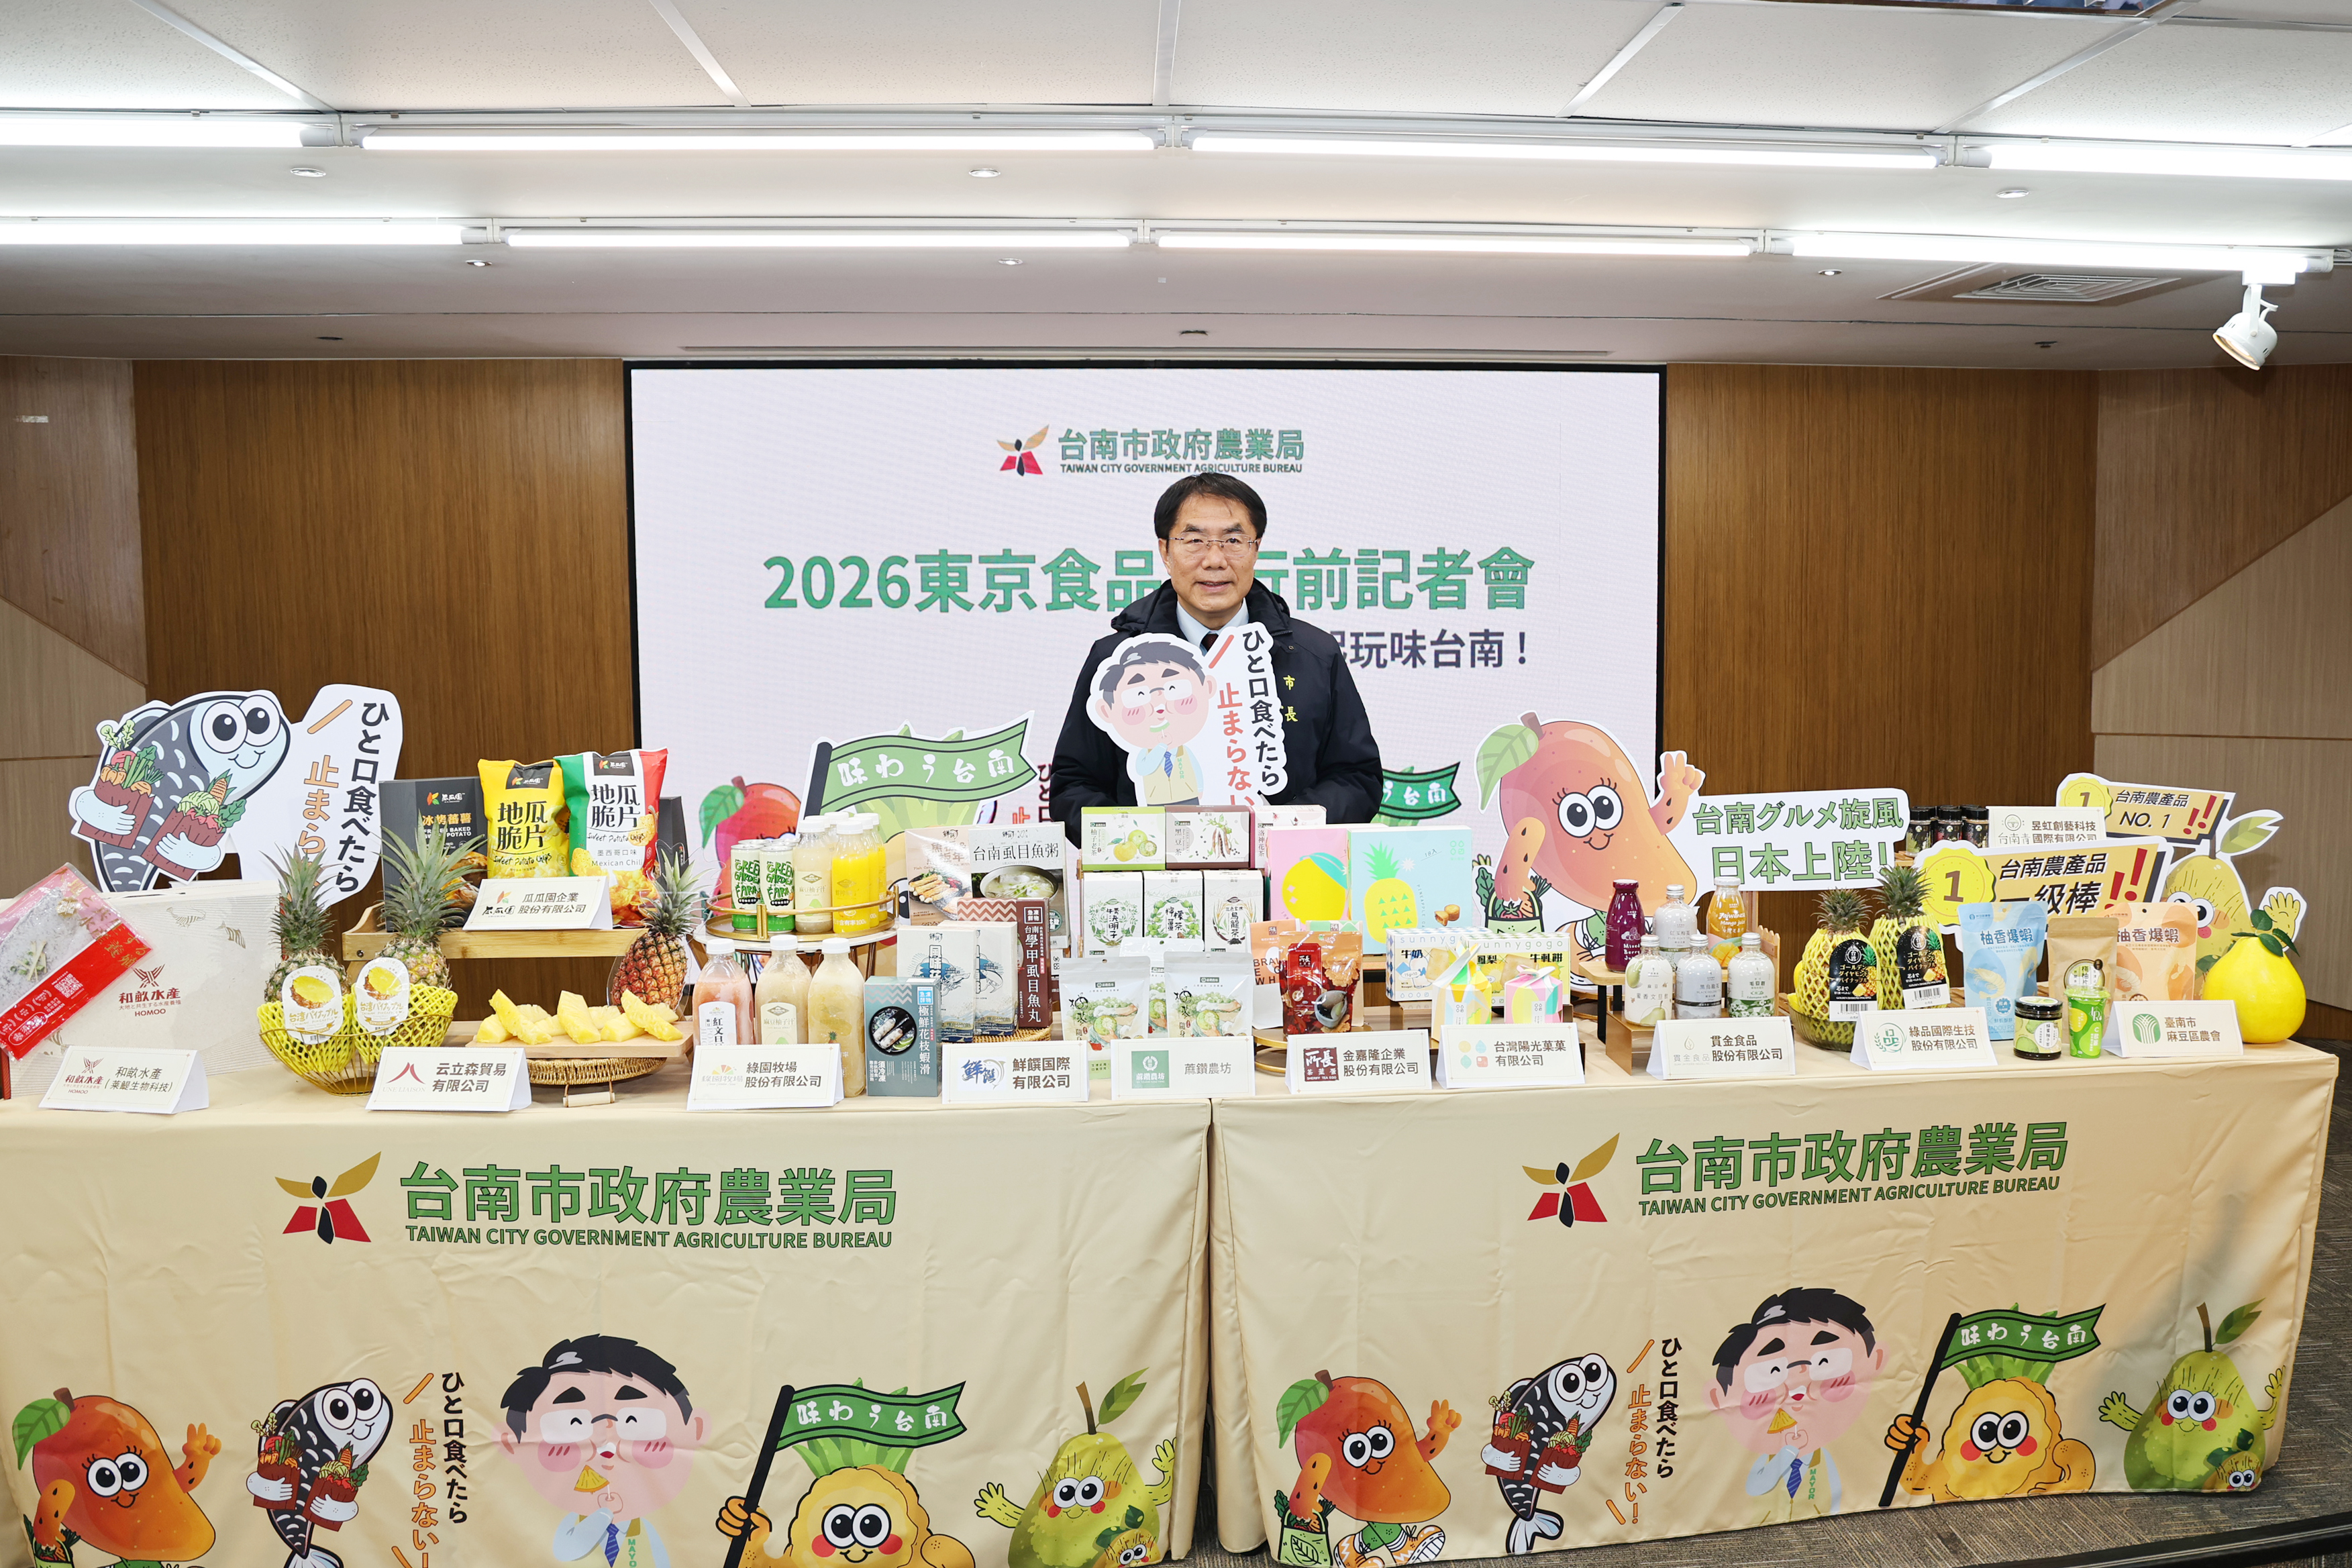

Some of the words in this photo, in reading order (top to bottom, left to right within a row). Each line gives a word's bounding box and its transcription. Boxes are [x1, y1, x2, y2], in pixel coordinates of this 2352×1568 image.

[1058, 428, 1305, 461] 台南市政府農業局
[1060, 463, 1098, 474] TAIWAN
[1101, 463, 1123, 474] CITY
[1124, 463, 1192, 474] GOVERNMENT
[1194, 463, 1263, 474] AGRICULTURE
[1264, 463, 1303, 474] BUREAU
[1329, 629, 1527, 670] 玩味台南!
[1242, 629, 1280, 787] ひと口食べたら
[837, 748, 1015, 787] 味わう台南
[1177, 757, 1185, 779] MAYOR
[335, 702, 390, 892] ひと口食べたら
[591, 784, 641, 806] 地瓜
[2115, 790, 2190, 808] 台南農產品
[497, 800, 548, 825] 地瓜
[591, 805, 641, 829] 脆片
[1692, 797, 1904, 835] 台南グルメ旋風
[2119, 811, 2152, 829] NO.
[2163, 813, 2171, 829] 1
[2031, 819, 2097, 833] 昱虹創藝科技
[497, 824, 547, 851] 脆片
[586, 832, 607, 843] Sweet
[630, 833, 646, 843] Chips
[493, 855, 513, 866] Sweet
[535, 851, 552, 865] Chips
[597, 848, 637, 857] 墨西哥口味
[972, 842, 1060, 861] 台南虱目魚粥
[1424, 848, 1438, 858] 18入
[1998, 852, 2108, 881] 台南農產品
[1943, 870, 1965, 903] 1
[521, 892, 579, 903] 瓜瓜園企業
[517, 904, 586, 914] 股份有限公司
[1024, 925, 1039, 934] 台南
[2116, 927, 2180, 943] 柚香爆蝦
[1483, 940, 1564, 951] unnygogo
[1980, 930, 2035, 946] 柚香爆蝦
[1400, 949, 1424, 959] 牛奶
[1529, 953, 1563, 963] 牛軋餅
[1906, 955, 1935, 965] ダイヤモンド
[1907, 950, 1933, 958] ゴールデン
[1024, 933, 1041, 1023] 學甲虱目魚丸
[134, 1008, 166, 1017] HOMOO
[360, 1000, 404, 1012] 台湾パイナップル
[289, 1008, 339, 1023] 台湾パイナップル
[763, 1017, 797, 1026] 麻豆柚子汁
[2164, 1016, 2196, 1029] 臺南市
[712, 1016, 724, 1046] 紅文旦
[1908, 1024, 1976, 1037] 綠品國際生技
[2166, 1030, 2221, 1043] 麻豆區農會
[918, 1005, 931, 1076] 極鮮花枝蝦滑
[1494, 1040, 1567, 1053] 台灣陽光菓菓
[1710, 1035, 1757, 1047] 貫金食品
[1912, 1038, 1978, 1051] 股份有限公司
[1343, 1047, 1406, 1062] 金嘉隆企業
[1495, 1055, 1544, 1067] 有限公司
[1712, 1048, 1783, 1062] 股份有限公司
[436, 1062, 507, 1077] 云立森貿易
[746, 1061, 798, 1074] 綠園牧場
[1012, 1056, 1071, 1073] 鮮饌国際
[1343, 1062, 1419, 1077] 股份有限公司
[431, 1079, 490, 1093] 有限公司
[744, 1075, 822, 1088] 股份有限公司
[1012, 1074, 1071, 1090] 有限公司
[1635, 1121, 2069, 1195] 台南市政府農業局
[399, 1160, 897, 1227] 台南市政府農業局
[1638, 1196, 1706, 1216] TAIWAN
[1710, 1194, 1749, 1212] CITY
[1752, 1186, 1872, 1209] GOVERNMENT
[1874, 1180, 1990, 1202] AGRICULTURE
[1992, 1175, 2061, 1194] BUREAU
[405, 1225, 481, 1245] TAIWAN
[485, 1227, 529, 1246] CITY
[533, 1229, 670, 1247] GOVERNMENT
[673, 1231, 808, 1249] AGRICULTURE
[813, 1231, 892, 1248] BUREAU
[1960, 1322, 2086, 1350] 味わう台南
[796, 1400, 948, 1432] 味わう台南
[1655, 1337, 1683, 1479] ひと口食べたら
[441, 1371, 468, 1524] ひと口食べたら
[1624, 1383, 1653, 1524] 止まらない!
[1807, 1468, 1817, 1500] MAYOR
